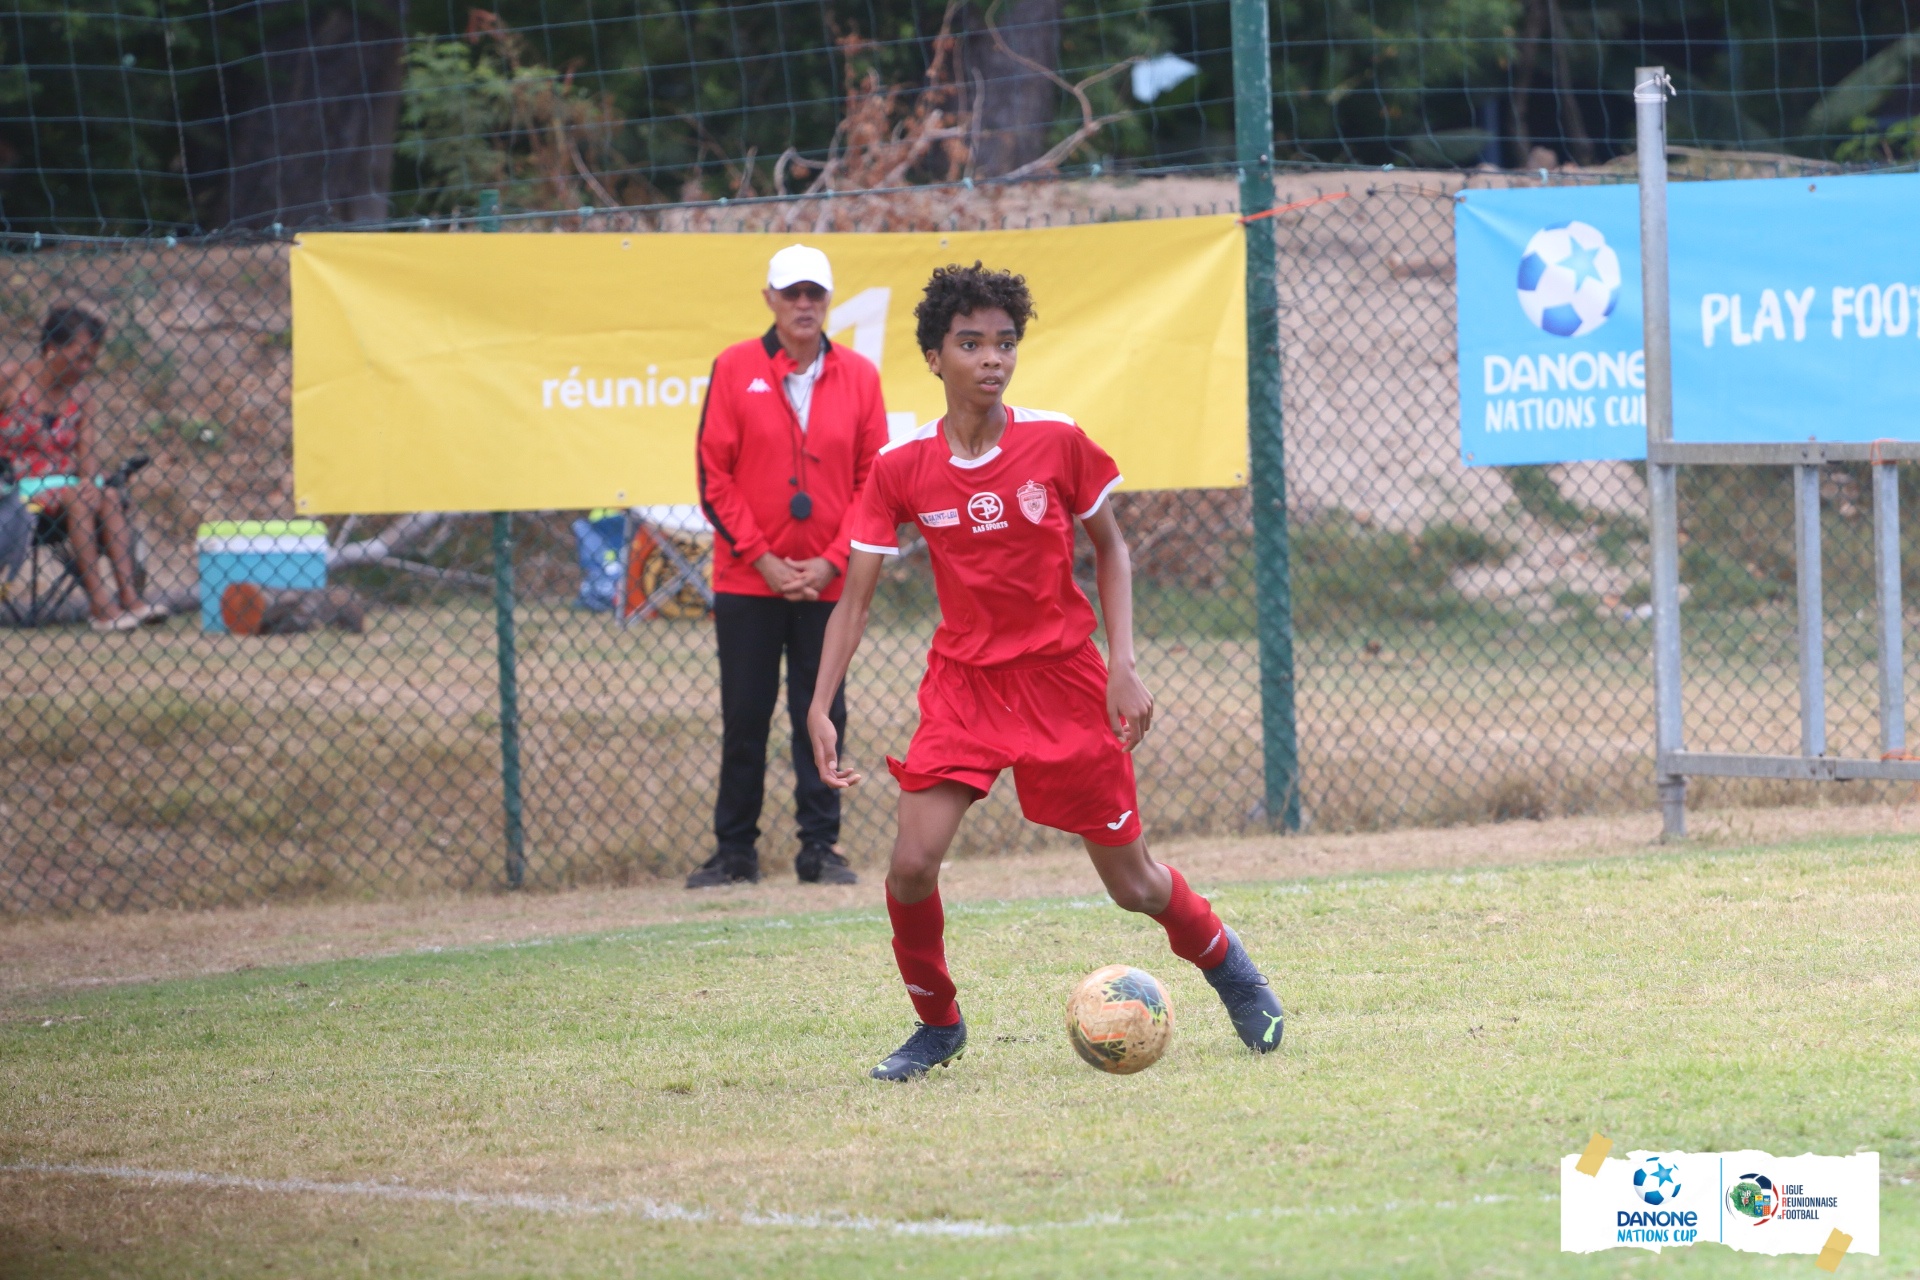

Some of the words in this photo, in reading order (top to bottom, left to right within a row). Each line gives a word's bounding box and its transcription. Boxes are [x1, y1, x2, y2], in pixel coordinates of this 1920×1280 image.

[1701, 286, 1815, 348] PLAY
[1485, 397, 1596, 433] NATIONS
[972, 524, 985, 533] RAS
[985, 521, 1009, 531] SPORTS
